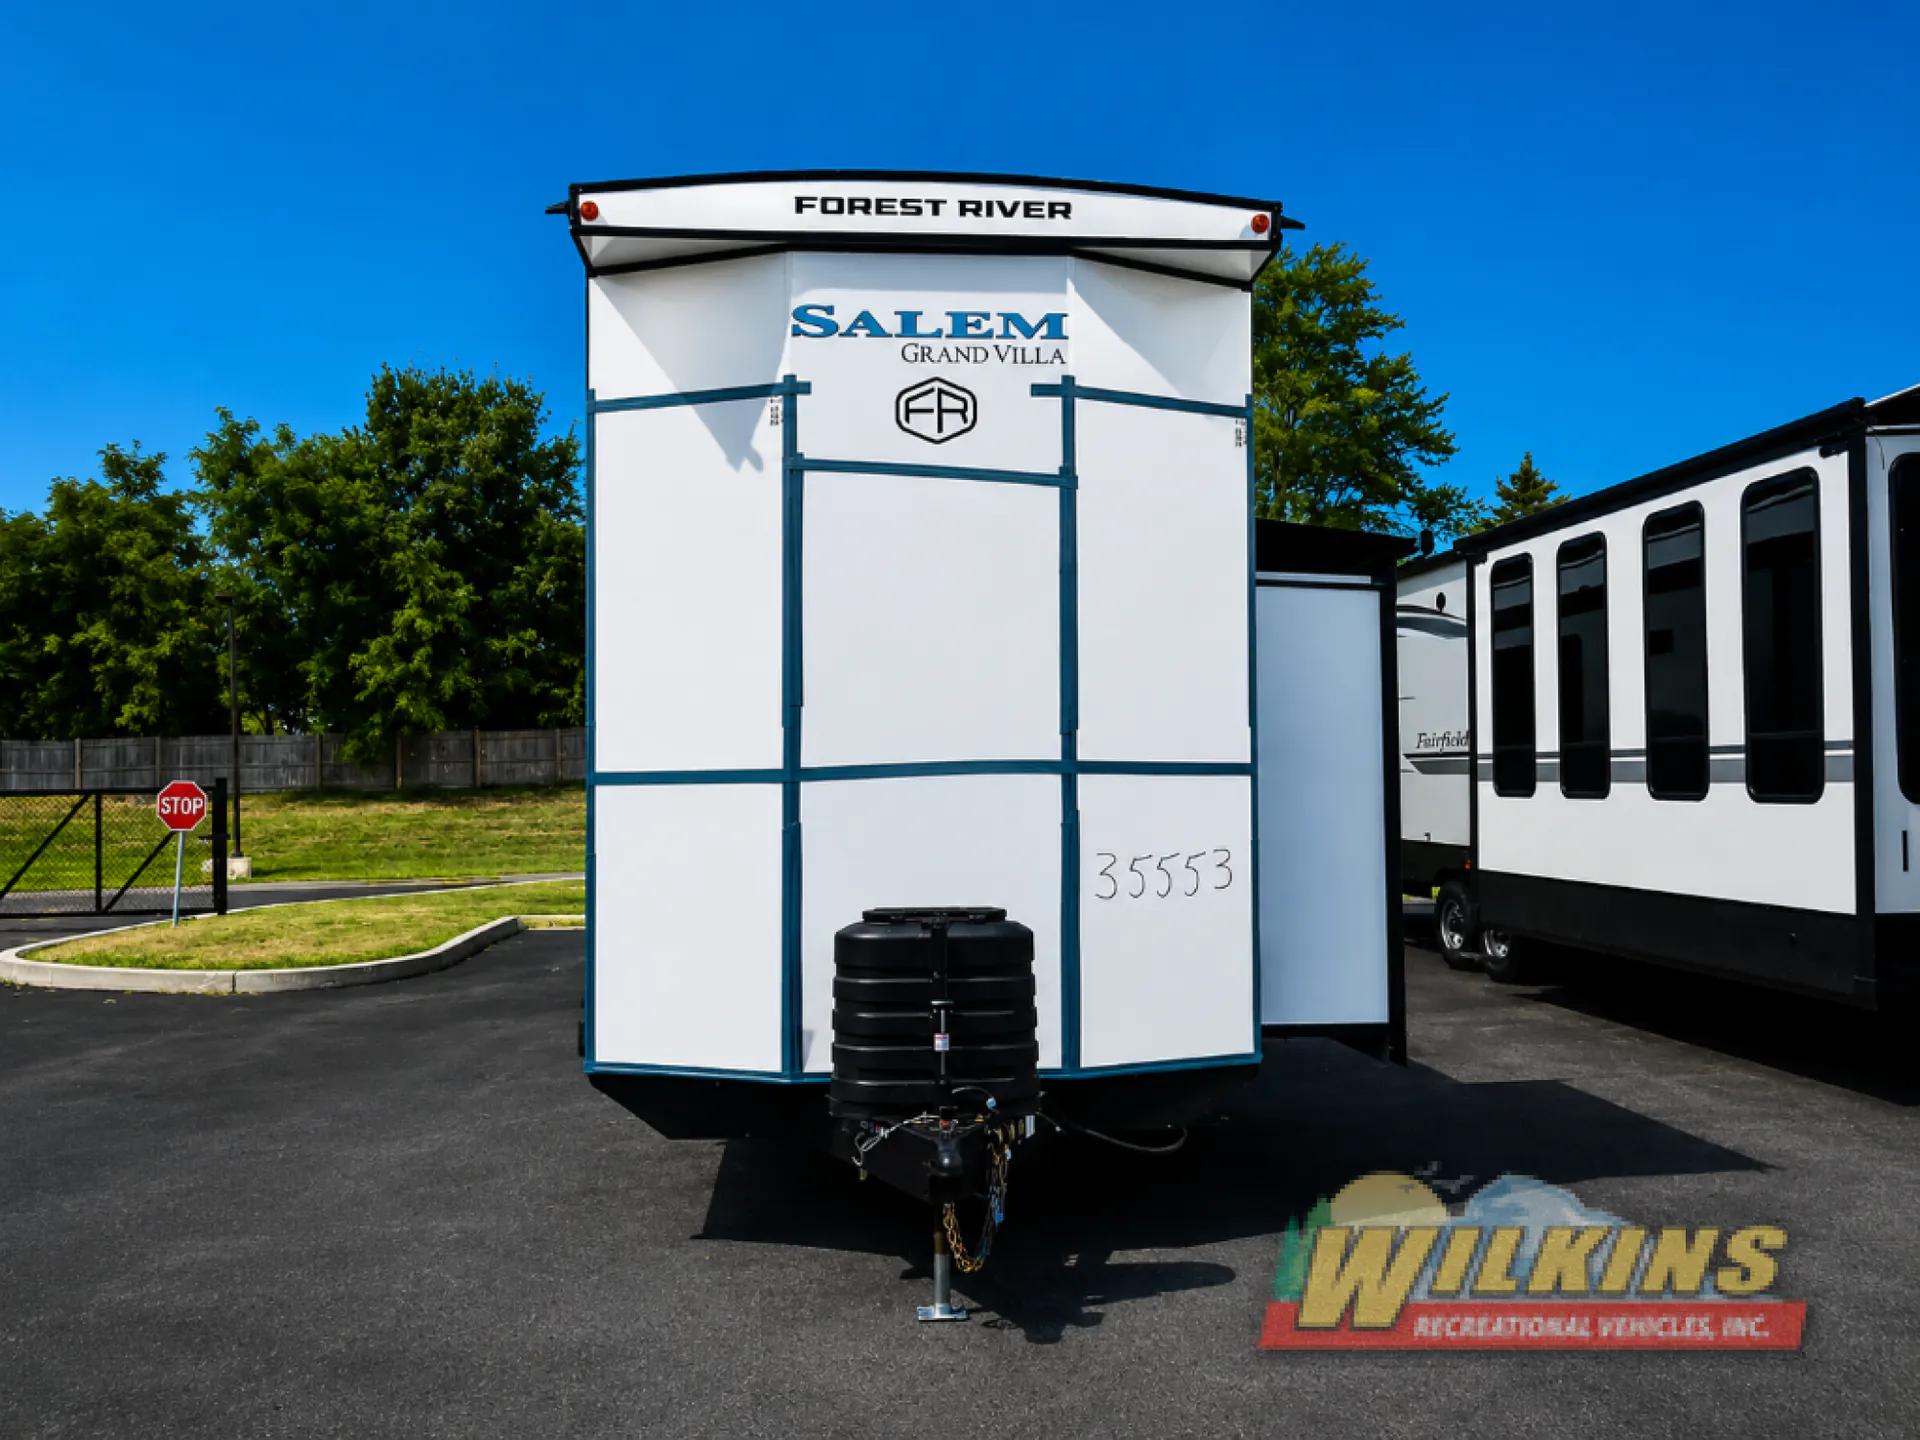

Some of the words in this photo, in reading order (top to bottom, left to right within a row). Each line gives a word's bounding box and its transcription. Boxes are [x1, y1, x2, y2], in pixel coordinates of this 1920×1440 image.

[795, 196, 947, 216] FOREST
[957, 197, 1072, 219] RIVER
[791, 304, 1069, 338] SALEM
[900, 342, 988, 364] GRAND
[991, 344, 1067, 365] VILLA
[1416, 731, 1470, 753] Fairfield
[160, 796, 203, 815] STOP
[1095, 848, 1233, 900] 35553
